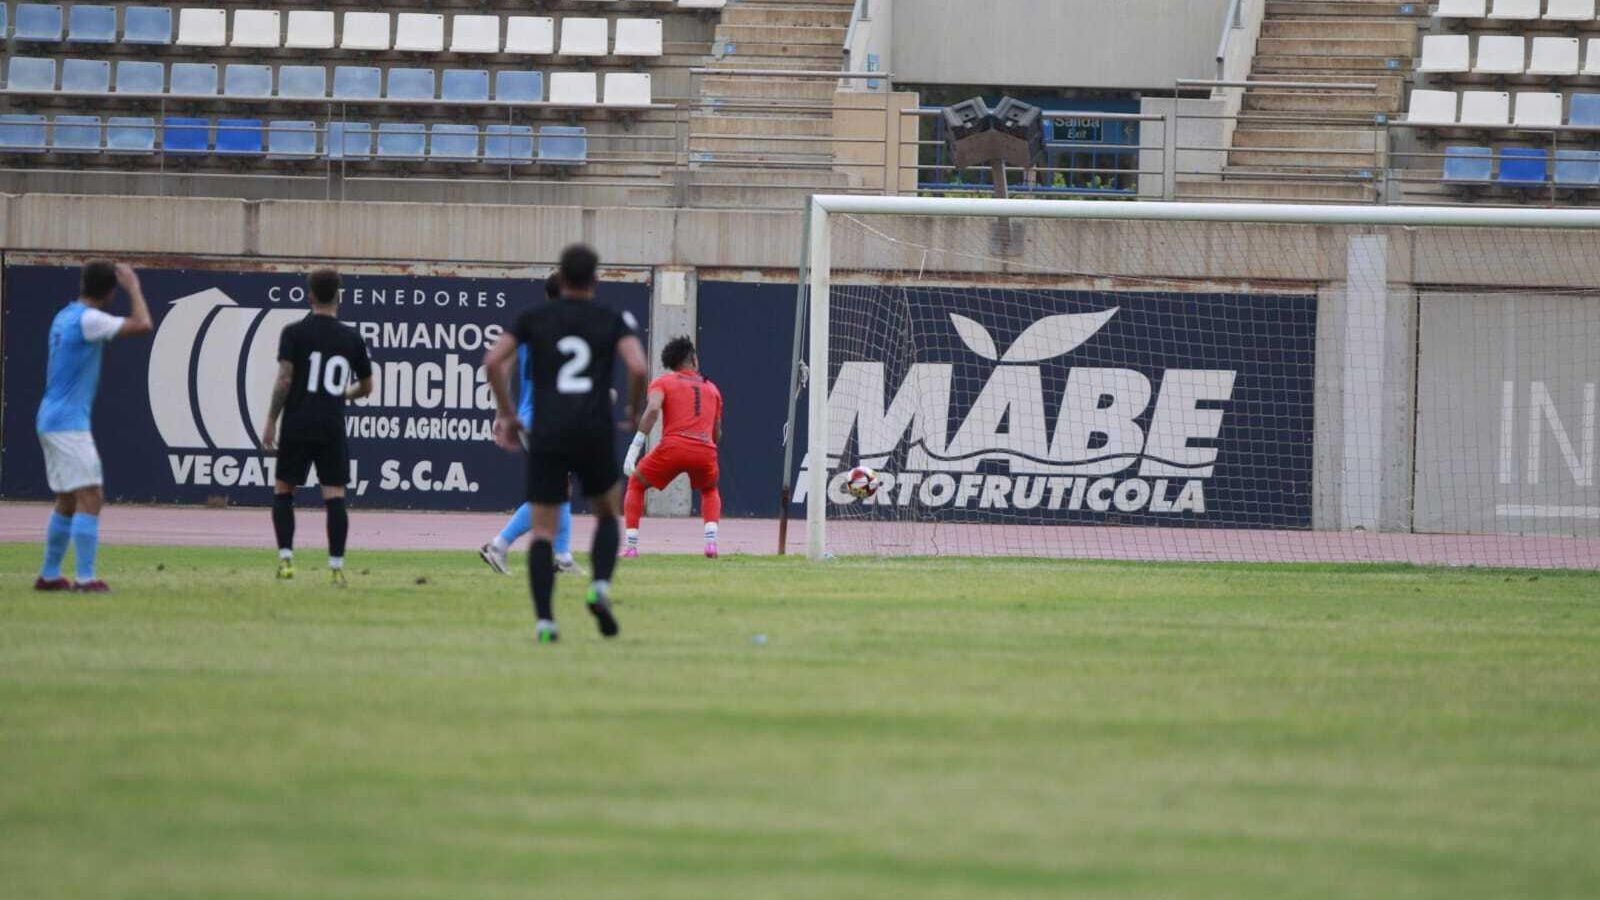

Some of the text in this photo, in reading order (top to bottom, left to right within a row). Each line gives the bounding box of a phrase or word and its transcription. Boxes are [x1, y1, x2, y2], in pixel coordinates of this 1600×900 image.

[268, 286, 507, 308] COTENEDORES
[340, 321, 504, 351] RMANOS
[307, 351, 350, 396] 10
[345, 353, 498, 410] ancha
[556, 335, 593, 393] 2
[692, 386, 701, 416] 1
[801, 361, 1237, 479] MABE
[344, 411, 498, 441] VICIOS AGRÍCOLA
[1499, 381, 1595, 487] IN
[380, 459, 479, 492] S.C.A.
